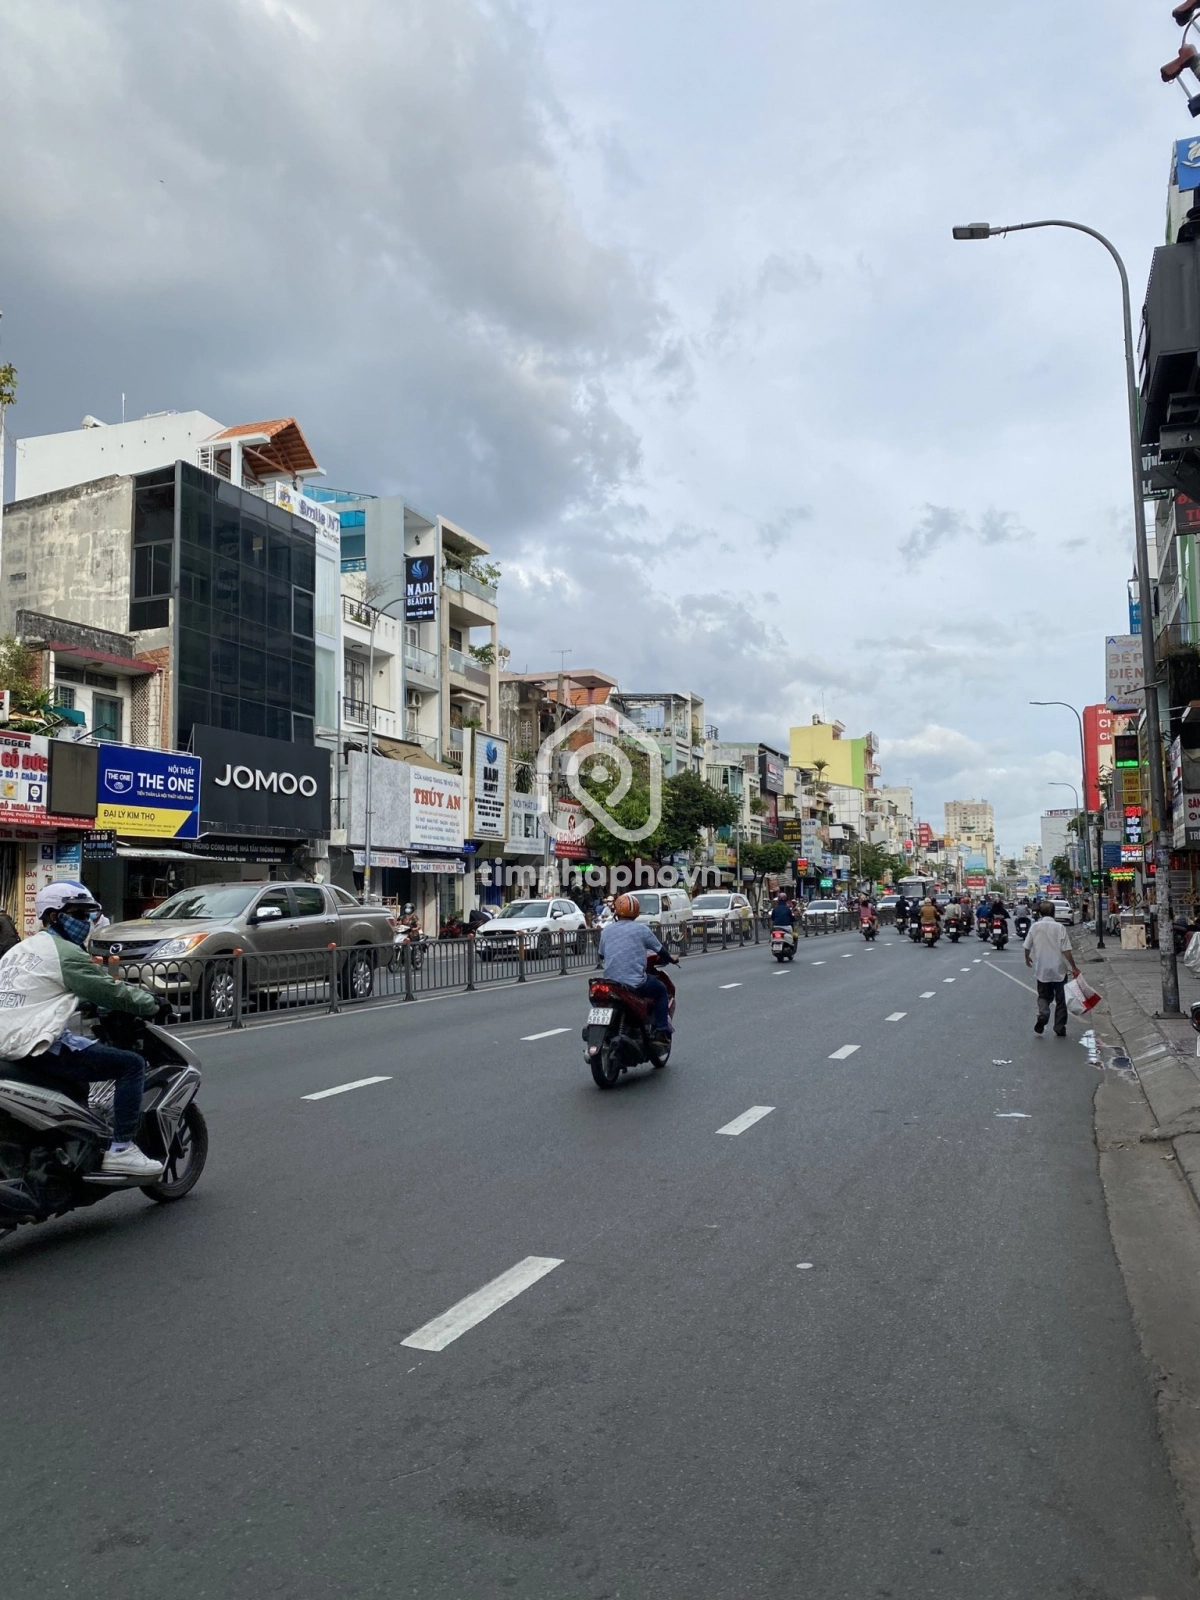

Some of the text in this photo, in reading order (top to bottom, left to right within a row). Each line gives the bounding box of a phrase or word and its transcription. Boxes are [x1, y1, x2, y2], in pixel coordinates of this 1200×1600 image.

[299, 499, 326, 525] Smile
[407, 582, 433, 596] NADI
[407, 596, 433, 606] BEAUTY
[1109, 649, 1143, 664] BẾP
[1108, 665, 1144, 680] ĐIỆN
[1, 748, 48, 772] GỖ ĐỨC
[5, 769, 13, 778] SỐ
[15, 771, 19, 779] 1
[168, 764, 195, 775] NỘI THẤT
[137, 772, 195, 793] THE ONE
[214, 764, 318, 797] JOMOO
[413, 787, 444, 808] THÚY
[446, 795, 462, 810] AN
[103, 809, 155, 822] ĐẠI LÝ KIM THỌ
[25, 870, 37, 878] SÀN
[41, 864, 53, 872] ACS
[26, 883, 35, 891] GỖ
